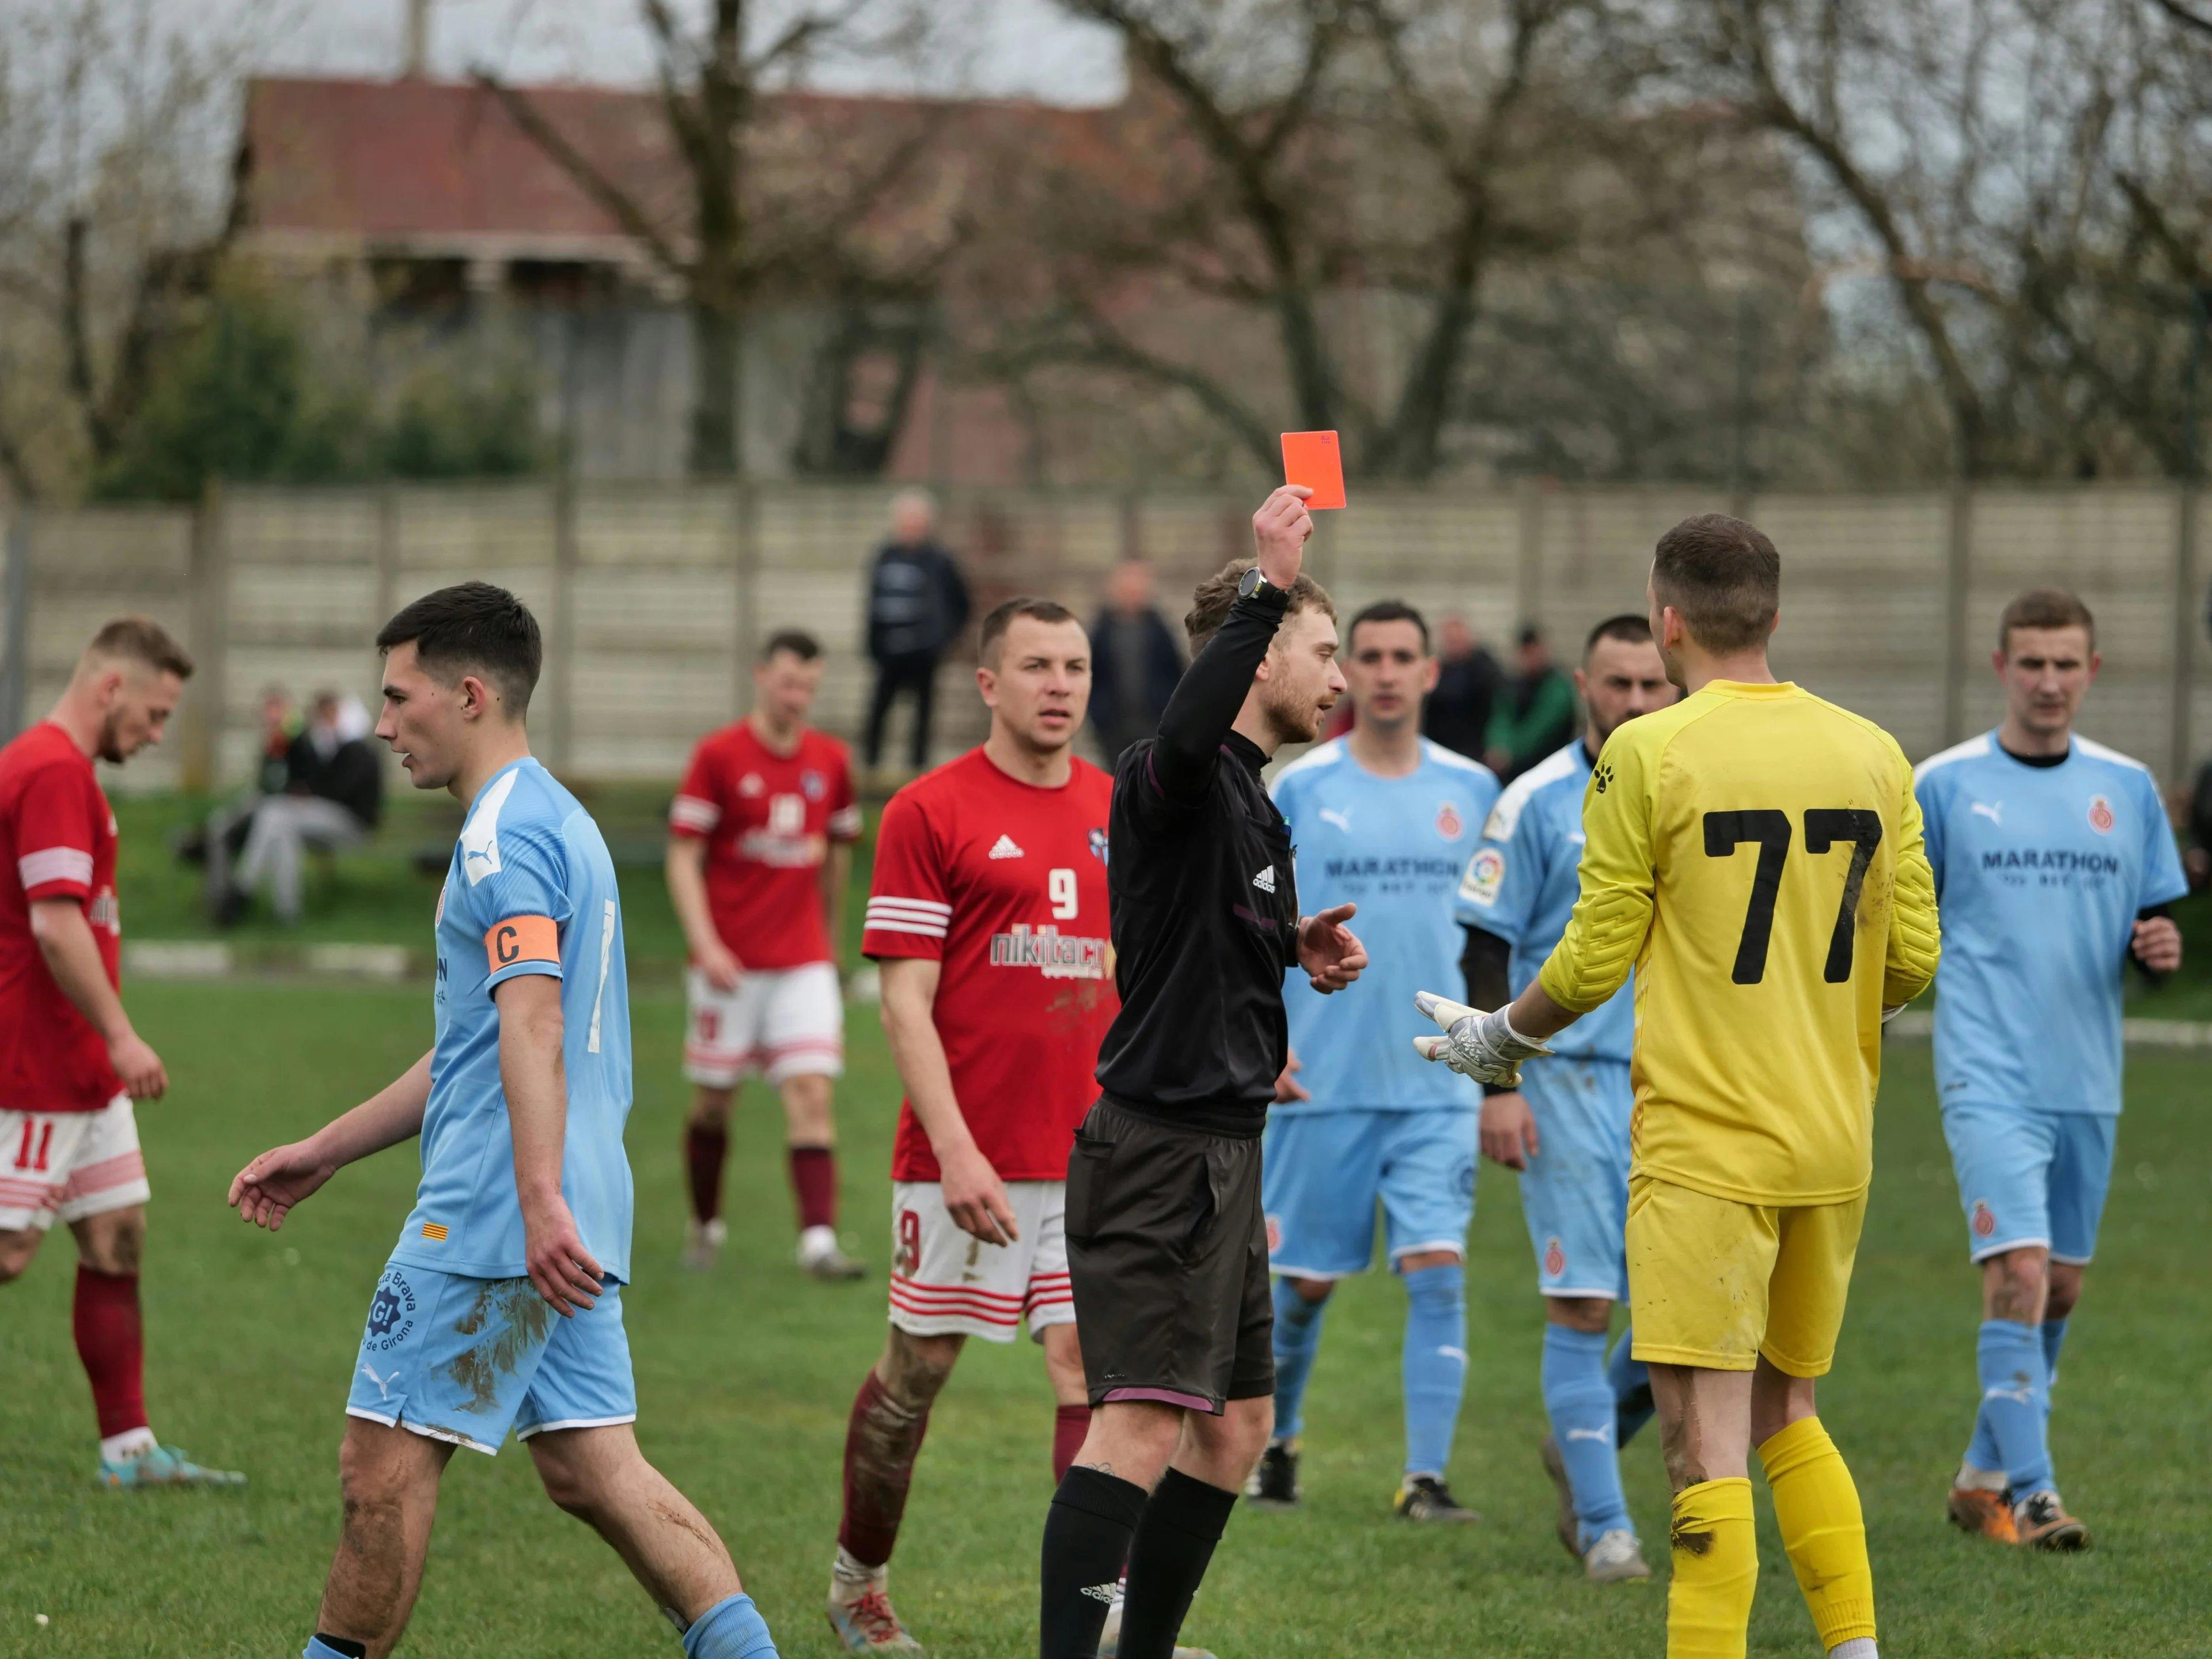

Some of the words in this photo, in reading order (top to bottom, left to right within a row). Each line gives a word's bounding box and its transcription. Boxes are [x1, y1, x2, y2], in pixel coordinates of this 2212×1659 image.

[1982, 850, 2118, 875] MARATHON
[1048, 869, 1078, 920] 9
[1253, 878, 1276, 893] adidas
[1703, 809, 1883, 984] 77
[497, 926, 519, 963] C
[14, 1118, 52, 1171] 11
[901, 1210, 919, 1272] 9
[392, 1271, 416, 1312] Brava
[373, 1300, 393, 1327] G!
[366, 1340, 377, 1351] de
[381, 1320, 414, 1350] Girona
